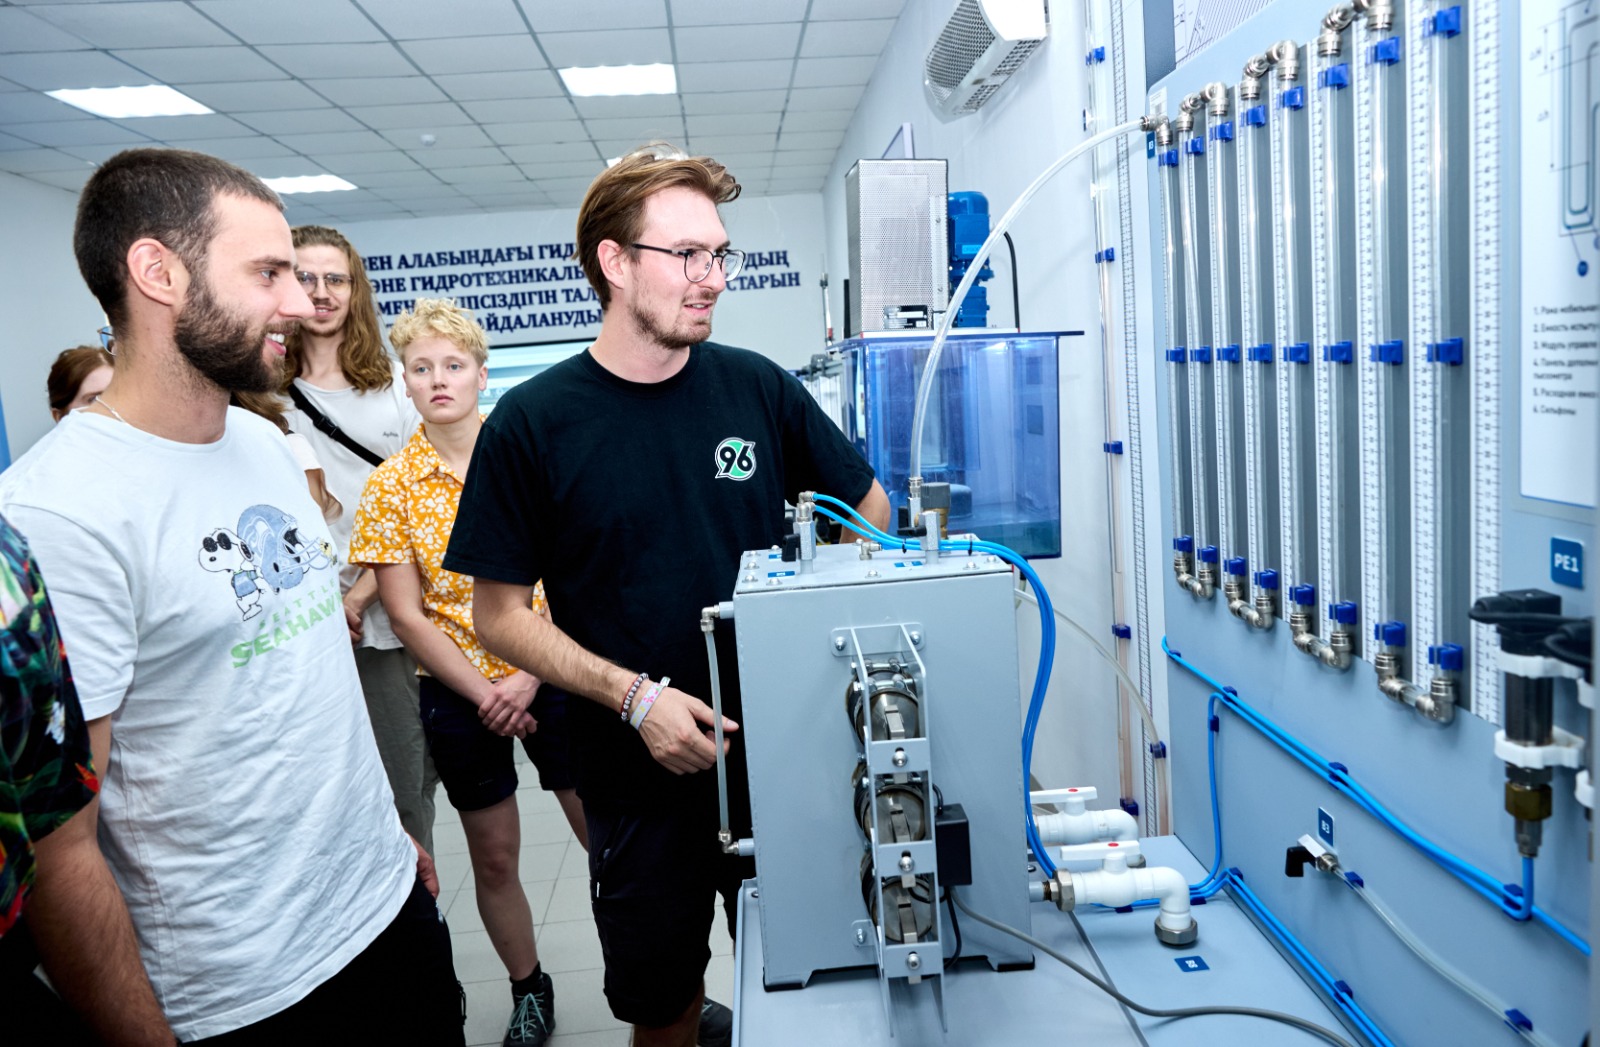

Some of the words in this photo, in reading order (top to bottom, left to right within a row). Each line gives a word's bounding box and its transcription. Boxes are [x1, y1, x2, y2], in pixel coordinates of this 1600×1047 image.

[397, 245, 534, 270] АЛАБЫНДАҒЫ
[717, 441, 755, 477] 96
[1554, 552, 1579, 573] PE1
